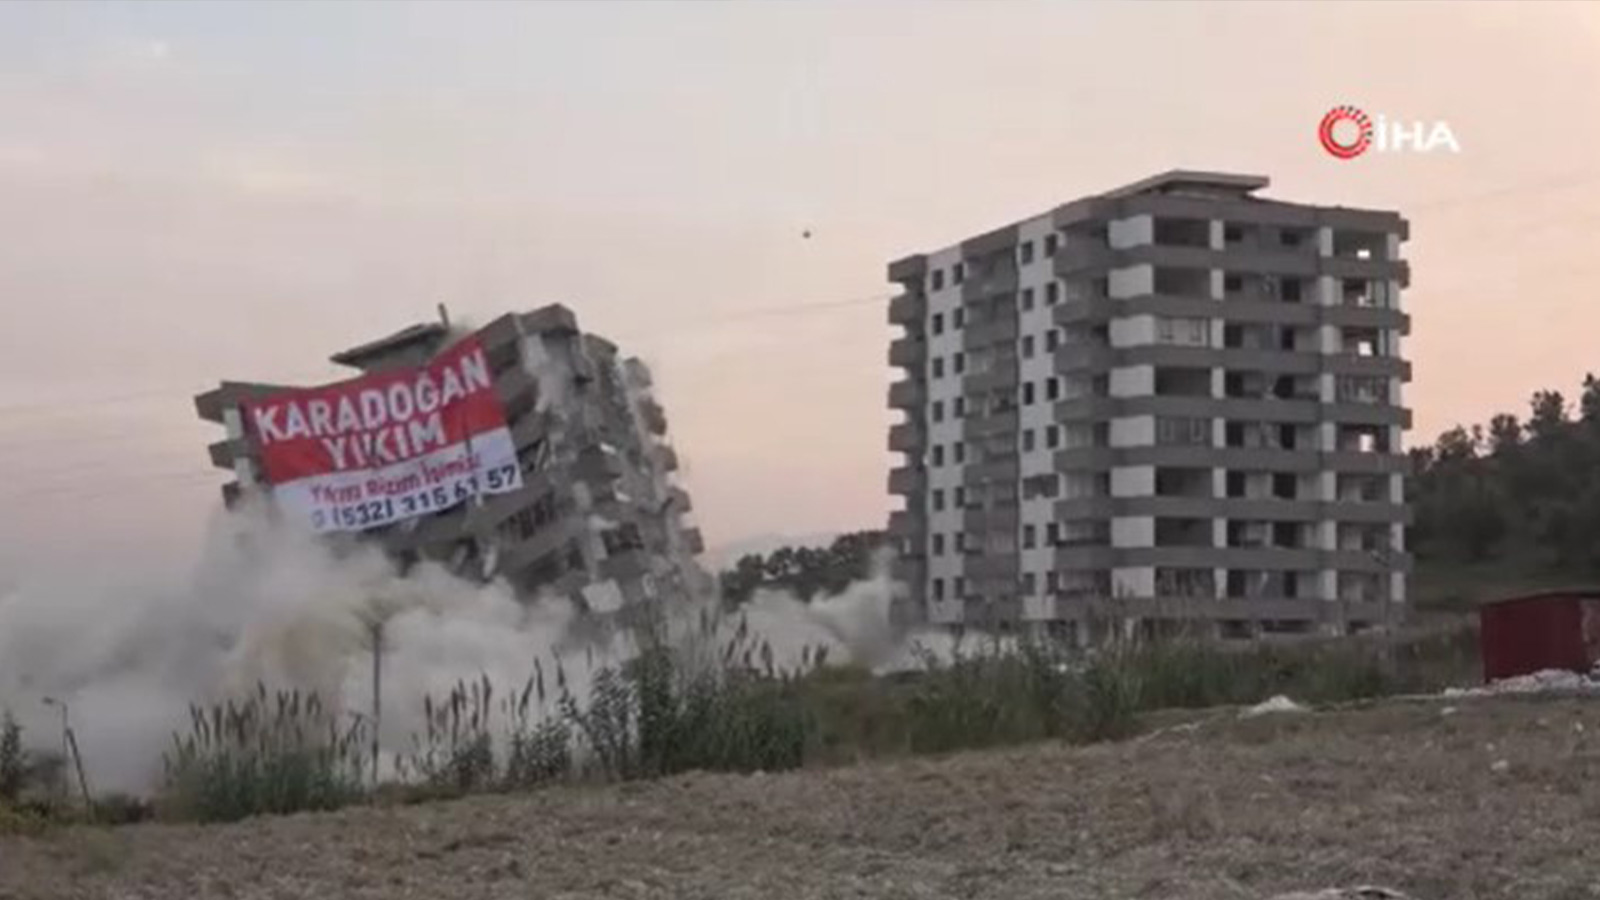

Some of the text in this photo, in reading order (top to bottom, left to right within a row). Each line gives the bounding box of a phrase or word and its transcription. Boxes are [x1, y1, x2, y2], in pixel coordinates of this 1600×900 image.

[253, 348, 491, 444] KARADOĞAN
[322, 411, 447, 469] YIKIM
[487, 464, 516, 489] 57
